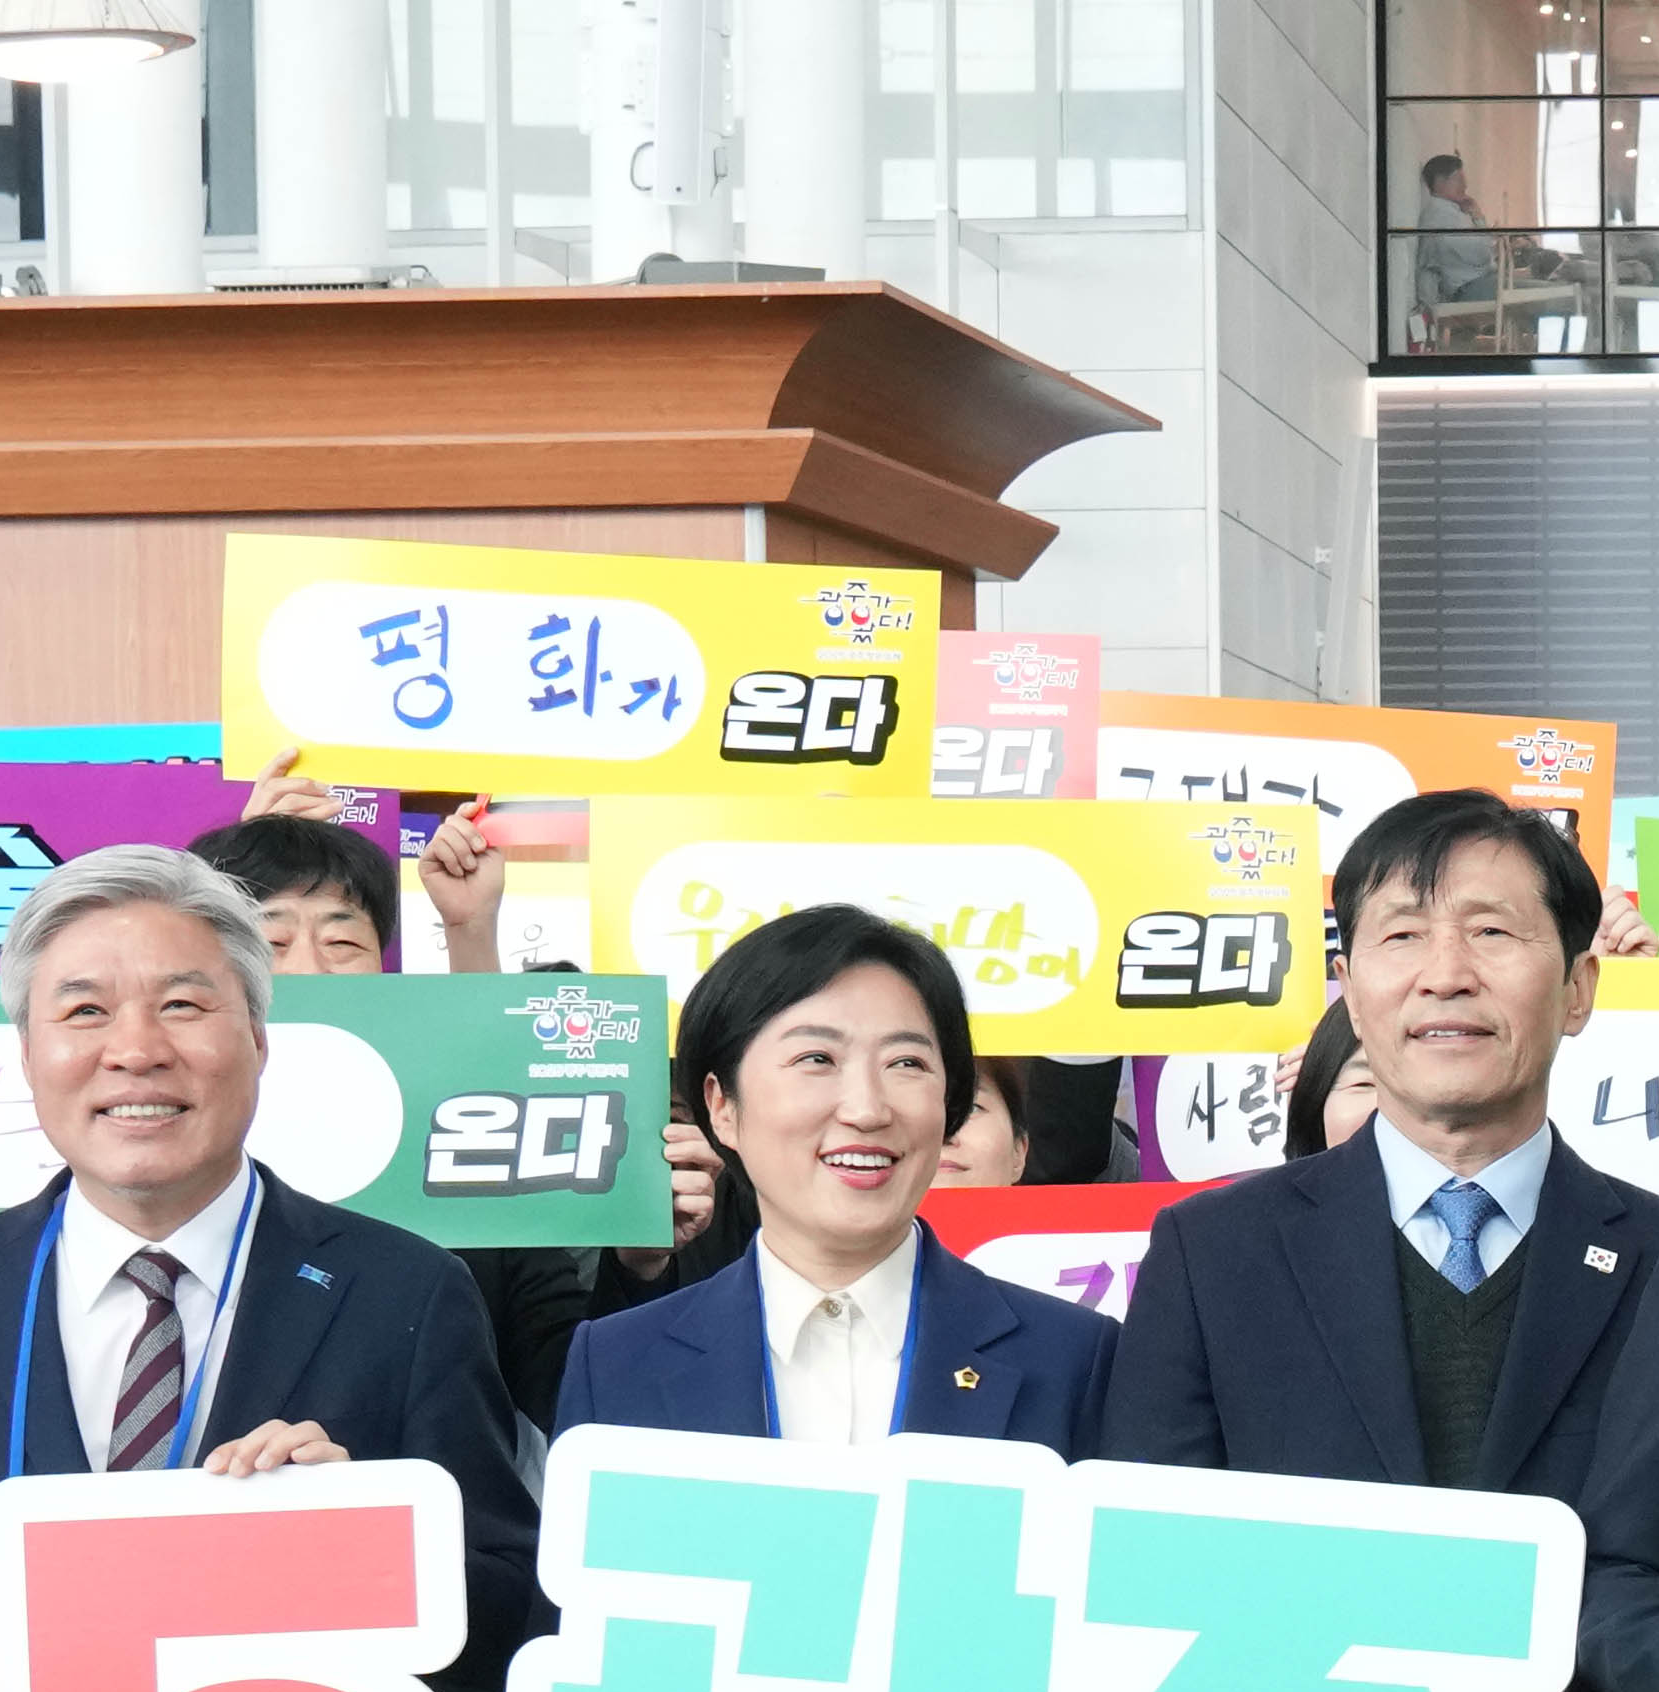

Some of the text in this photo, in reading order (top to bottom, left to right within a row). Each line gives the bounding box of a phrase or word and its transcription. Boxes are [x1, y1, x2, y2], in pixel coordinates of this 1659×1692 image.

[722, 674, 886, 754] 온다
[932, 726, 1054, 796] 온다
[1122, 914, 1279, 994] 온다
[426, 1092, 615, 1185] 온다
